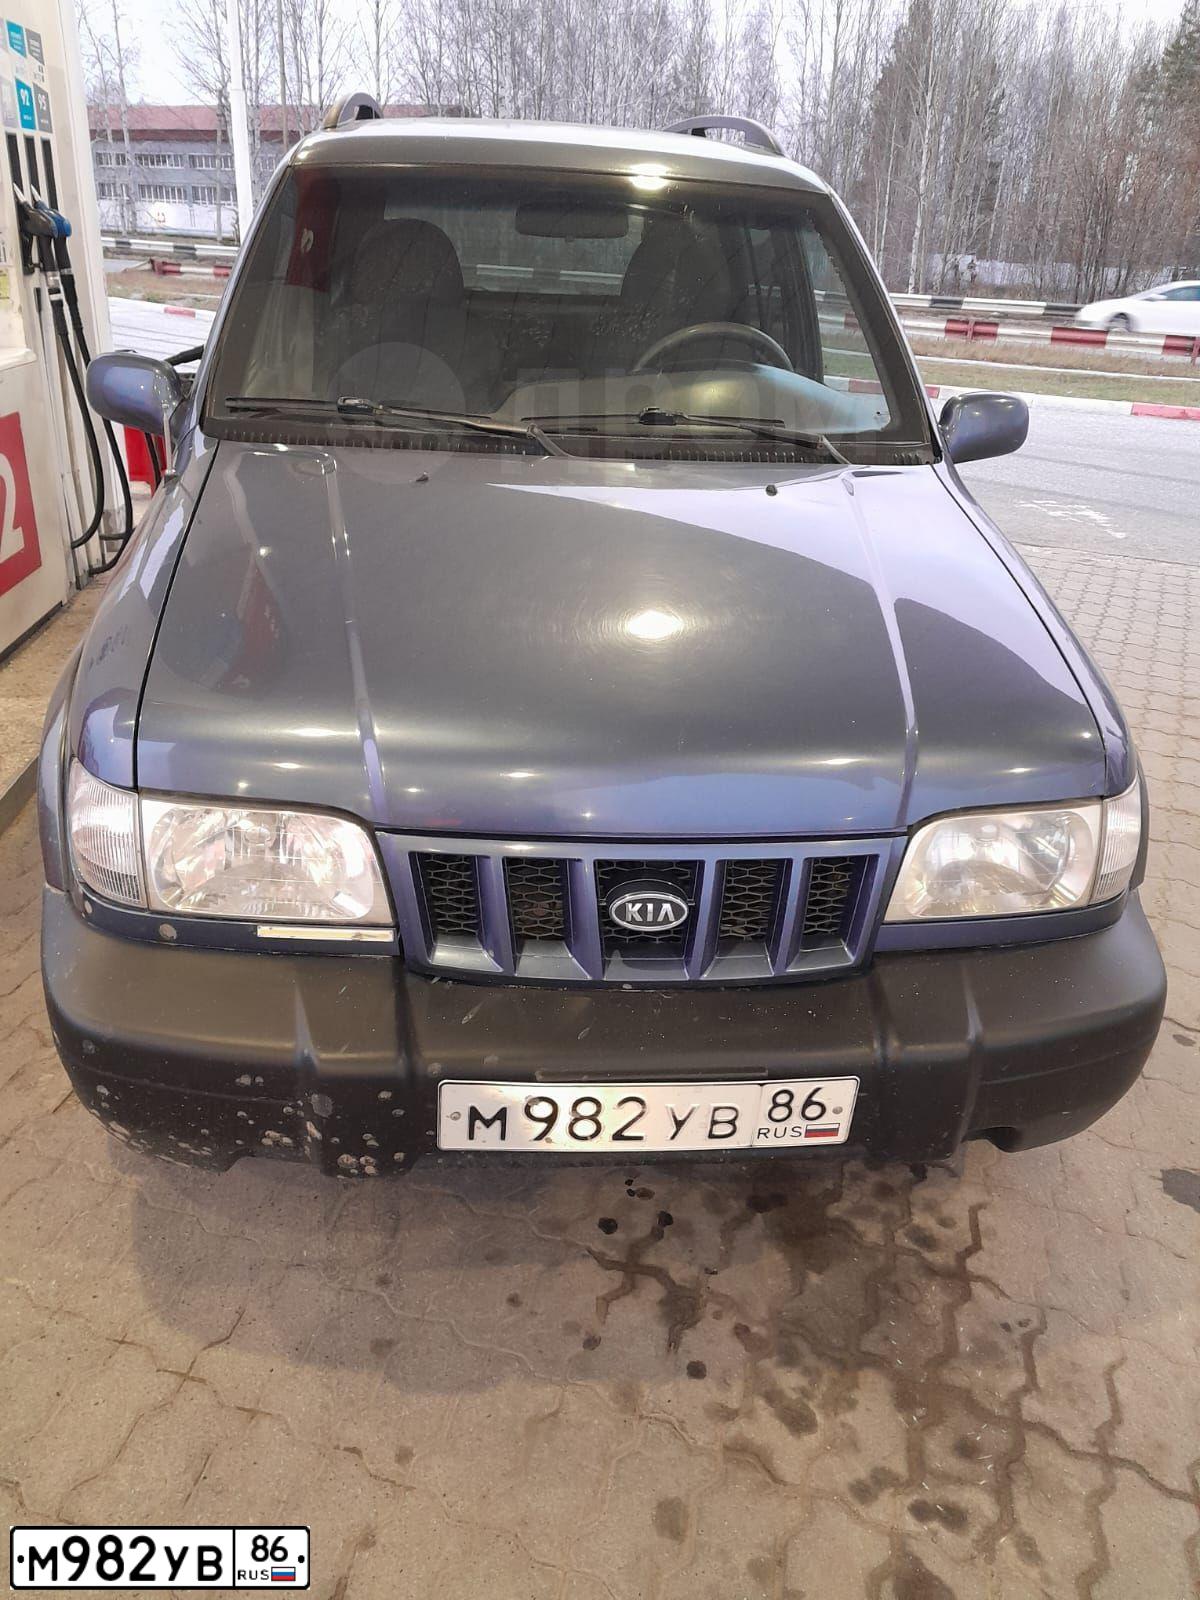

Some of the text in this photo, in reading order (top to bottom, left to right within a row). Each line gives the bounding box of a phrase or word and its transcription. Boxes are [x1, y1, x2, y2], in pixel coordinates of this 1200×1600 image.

[20, 88, 30, 106] 92
[625, 903, 675, 921] KIA
[767, 1087, 827, 1123] 86
[756, 1125, 802, 1140] RUS
